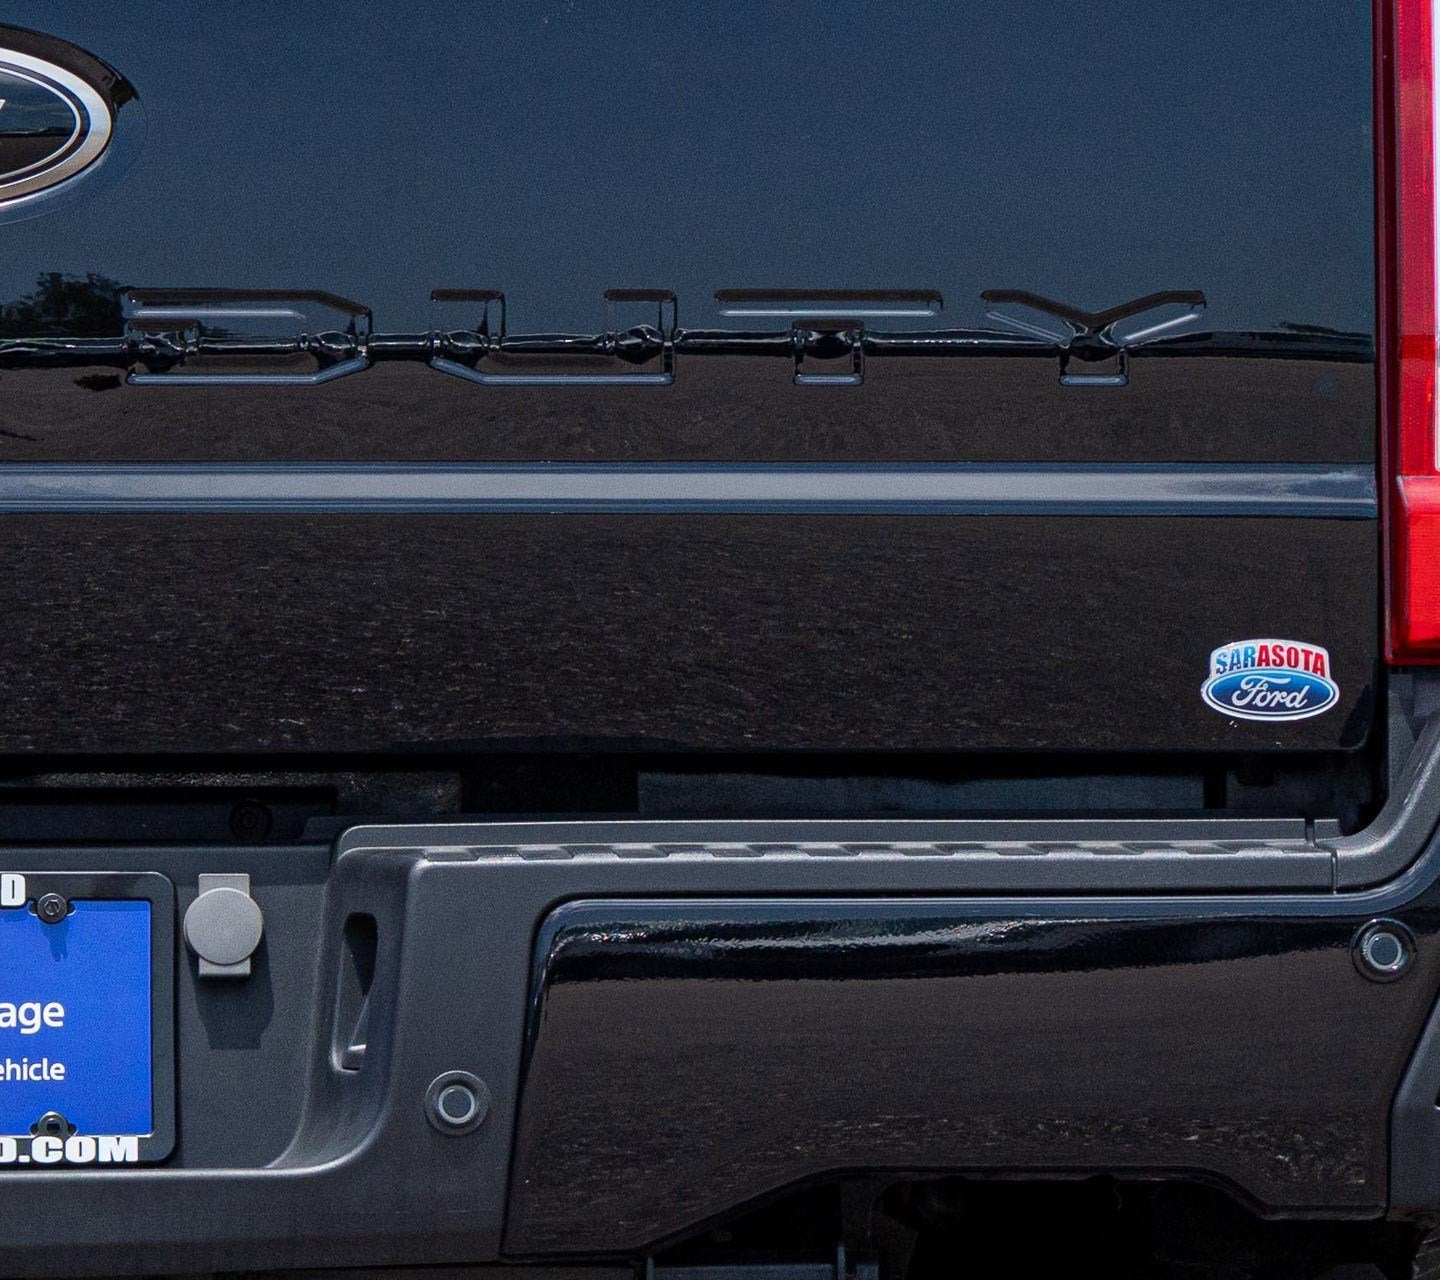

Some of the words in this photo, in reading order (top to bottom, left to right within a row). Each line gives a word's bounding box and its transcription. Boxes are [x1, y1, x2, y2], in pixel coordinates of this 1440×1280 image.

[119, 288, 1205, 387] DUTY
[1215, 644, 1326, 678] SARASOTA
[1231, 675, 1310, 708] Ford
